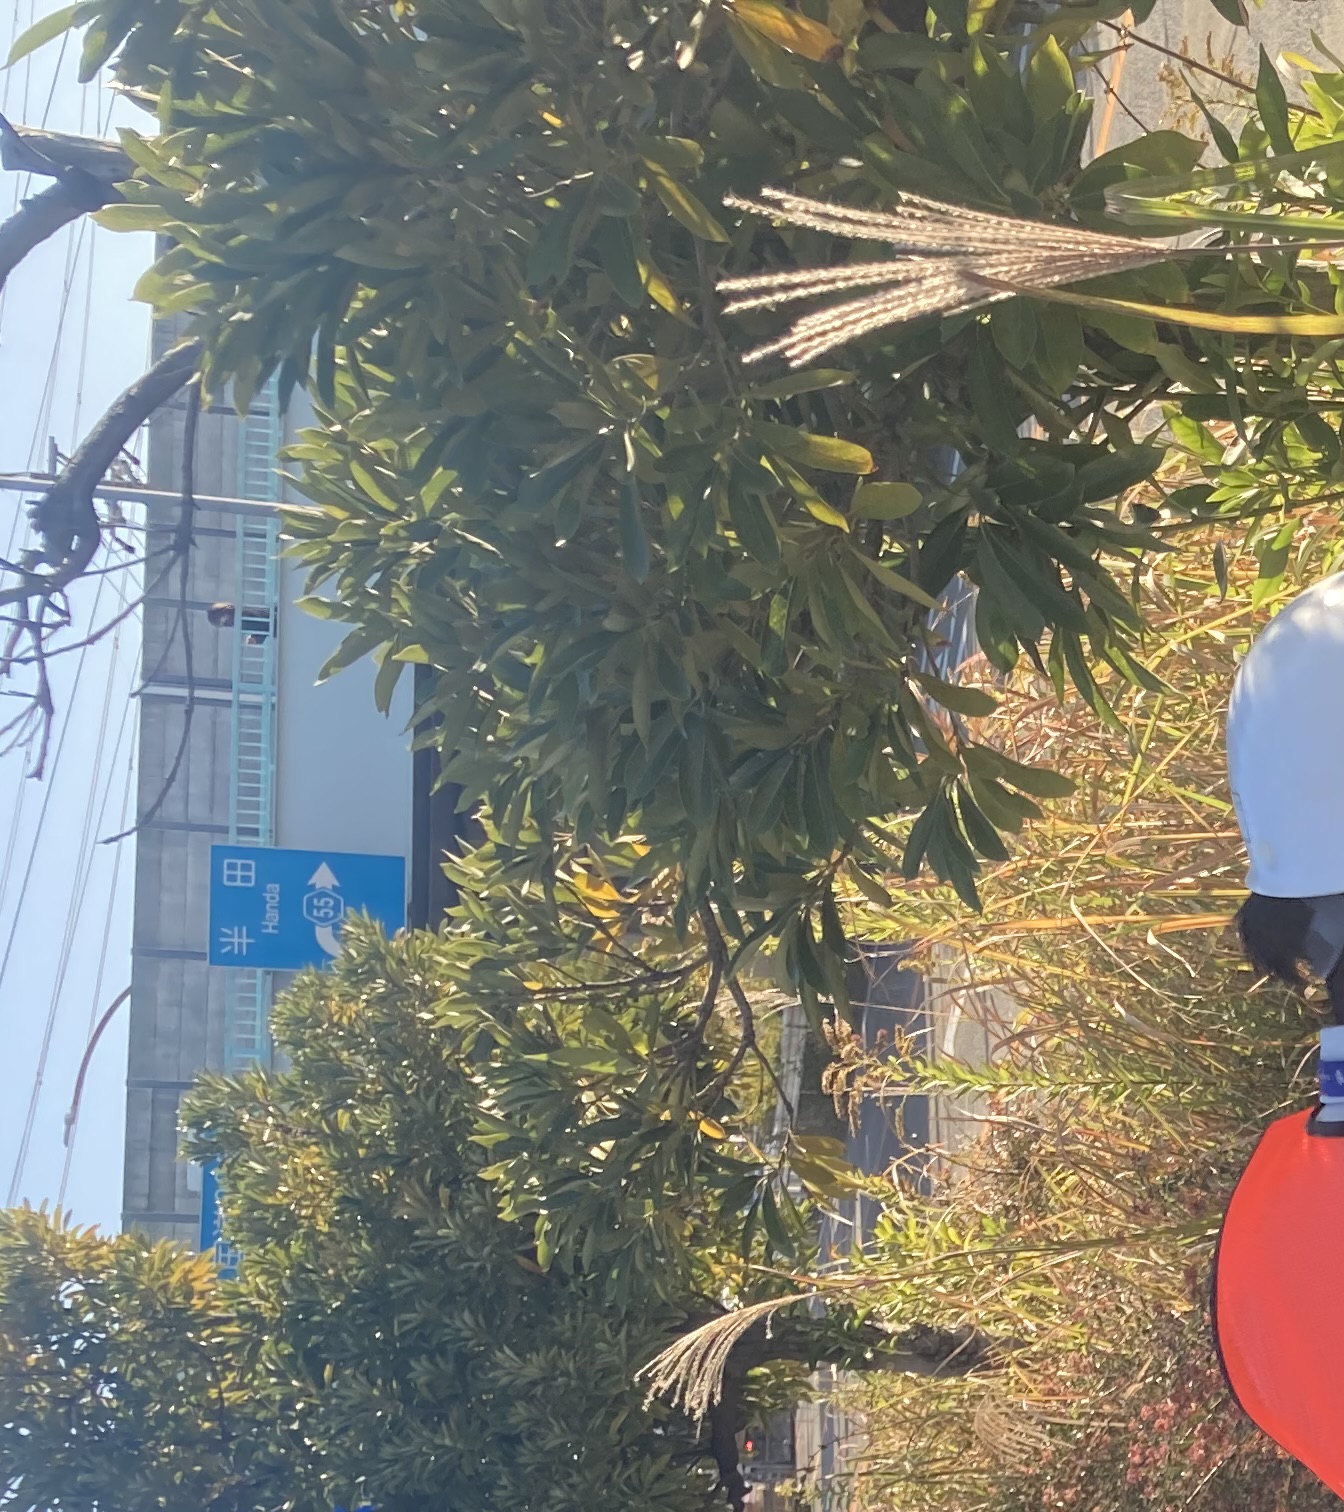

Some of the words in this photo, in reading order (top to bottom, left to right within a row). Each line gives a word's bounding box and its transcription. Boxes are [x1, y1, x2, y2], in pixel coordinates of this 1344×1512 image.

[219, 858, 256, 957] 半田
[260, 882, 280, 935] Handa
[312, 896, 335, 919] 55
